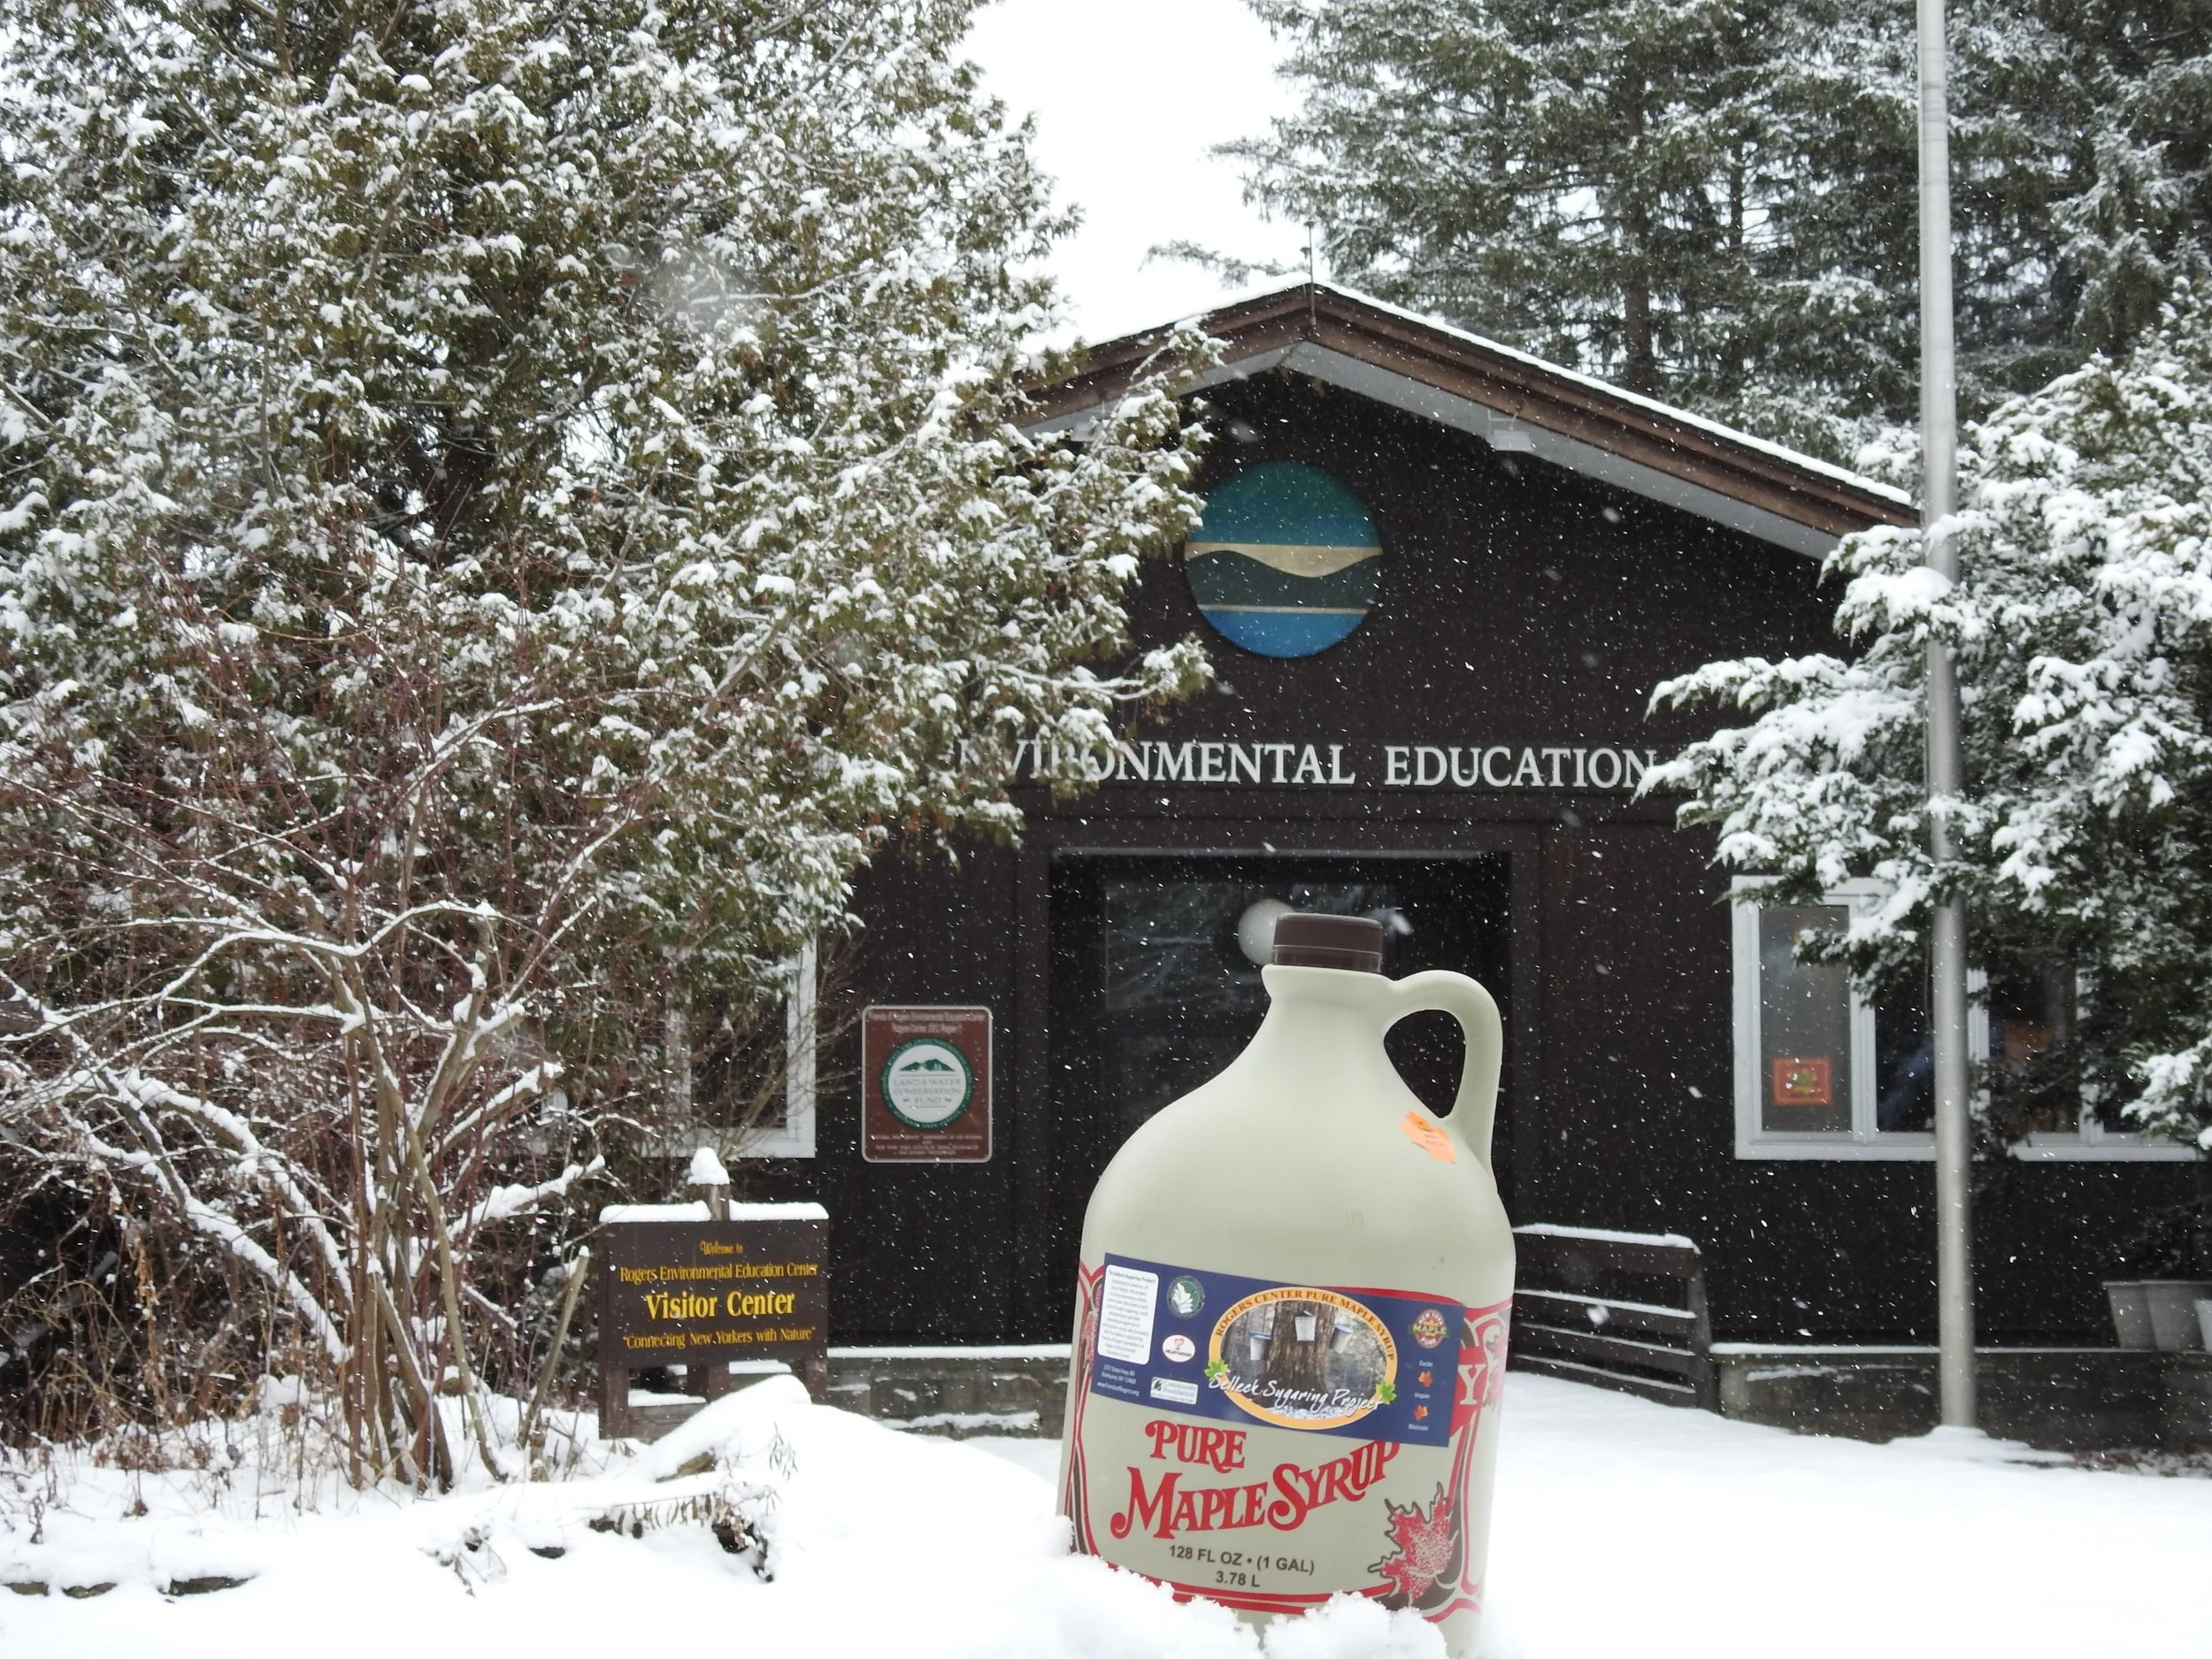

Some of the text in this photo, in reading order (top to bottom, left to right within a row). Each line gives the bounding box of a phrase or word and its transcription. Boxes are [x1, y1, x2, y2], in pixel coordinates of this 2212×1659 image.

[935, 739, 1657, 787] VIRONMENTAL EDUCATION
[929, 1078, 962, 1087] WATER
[700, 1240, 733, 1256] Welcome
[620, 1262, 818, 1285] Rogers Environmental Education Center
[646, 1289, 795, 1320] Visitor Center
[690, 1332, 711, 1346] New
[716, 1330, 752, 1345] Yorkers
[757, 1327, 777, 1342] with
[1215, 1290, 1395, 1361] ROGERS CENTER PURE MAPLE SYRUP
[1413, 1324, 1447, 1335] MAPLE
[1209, 1369, 1383, 1417] Selleck Sugaring Project
[1145, 1420, 1247, 1474] PURE
[1110, 1440, 1400, 1540] MAPLE SYRUP
[1169, 1545, 1315, 1575] 128 FL OZ (1 GAL)
[1216, 1571, 1260, 1587] 3.78 L
